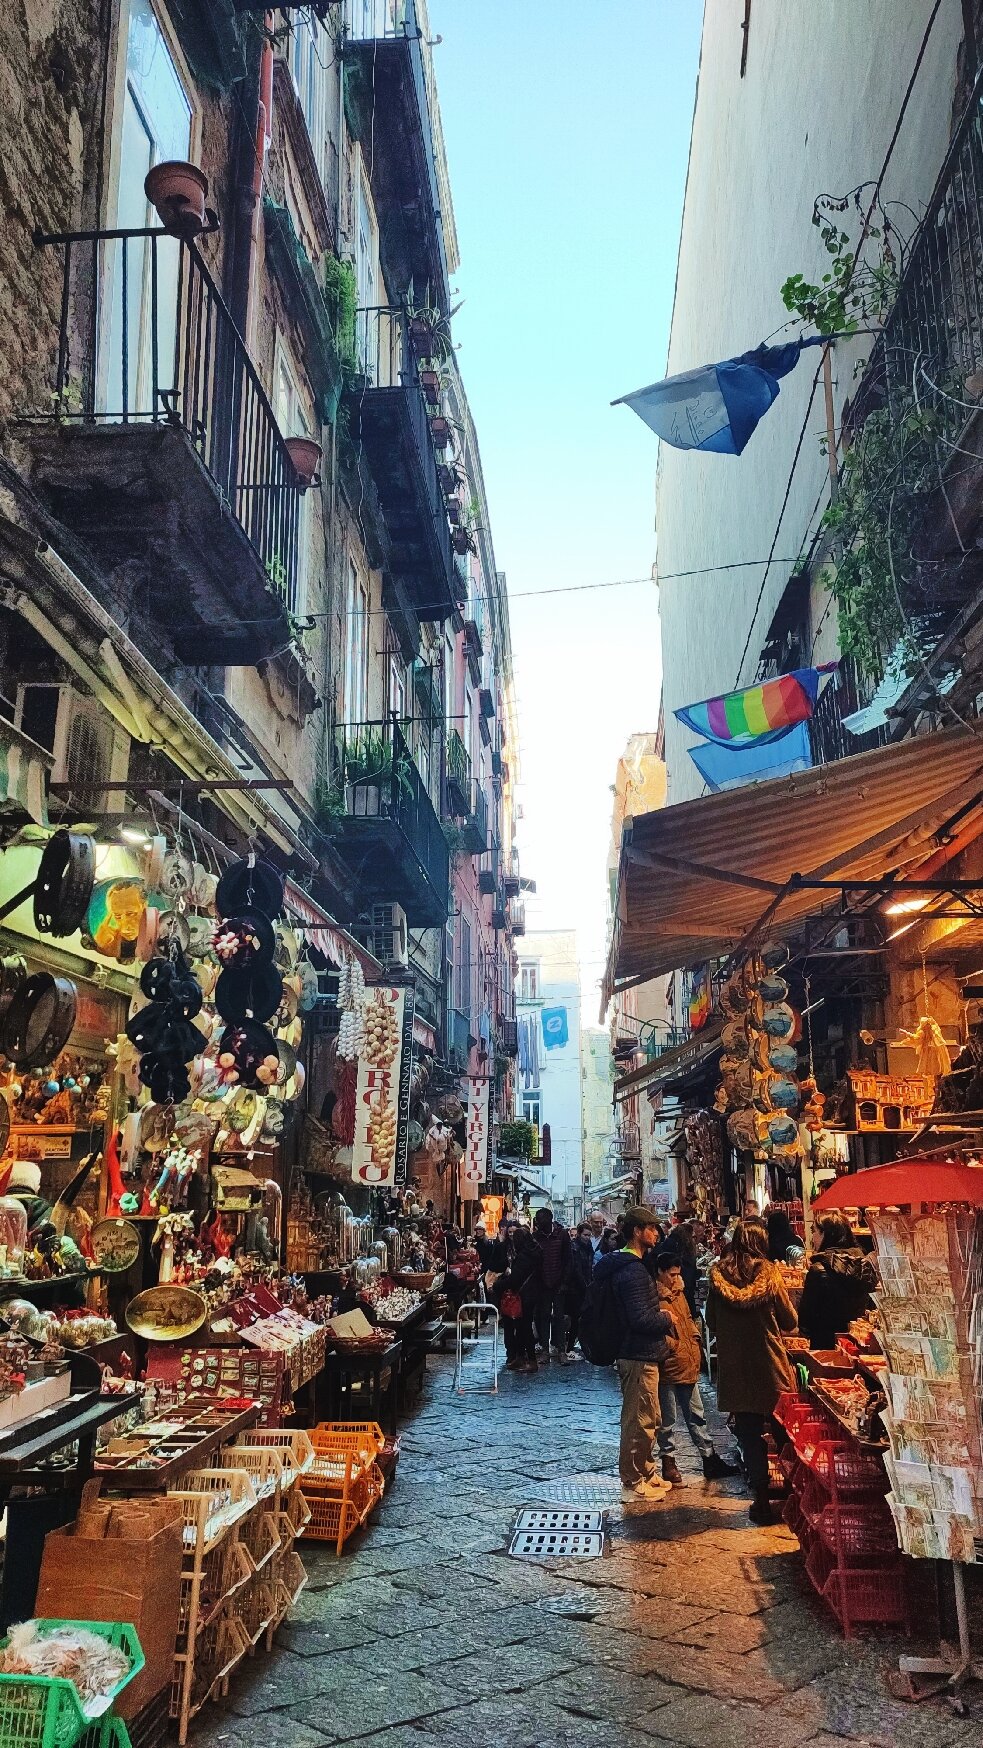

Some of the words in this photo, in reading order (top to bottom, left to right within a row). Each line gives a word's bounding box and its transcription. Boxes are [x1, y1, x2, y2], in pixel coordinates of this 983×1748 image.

[405, 988, 415, 1013] 1830
[405, 1020, 413, 1041] DAL
[400, 1046, 411, 1111] GENNARO
[395, 1125, 407, 1184] ROSARIO
[466, 1102, 486, 1181] VIRGILIO
